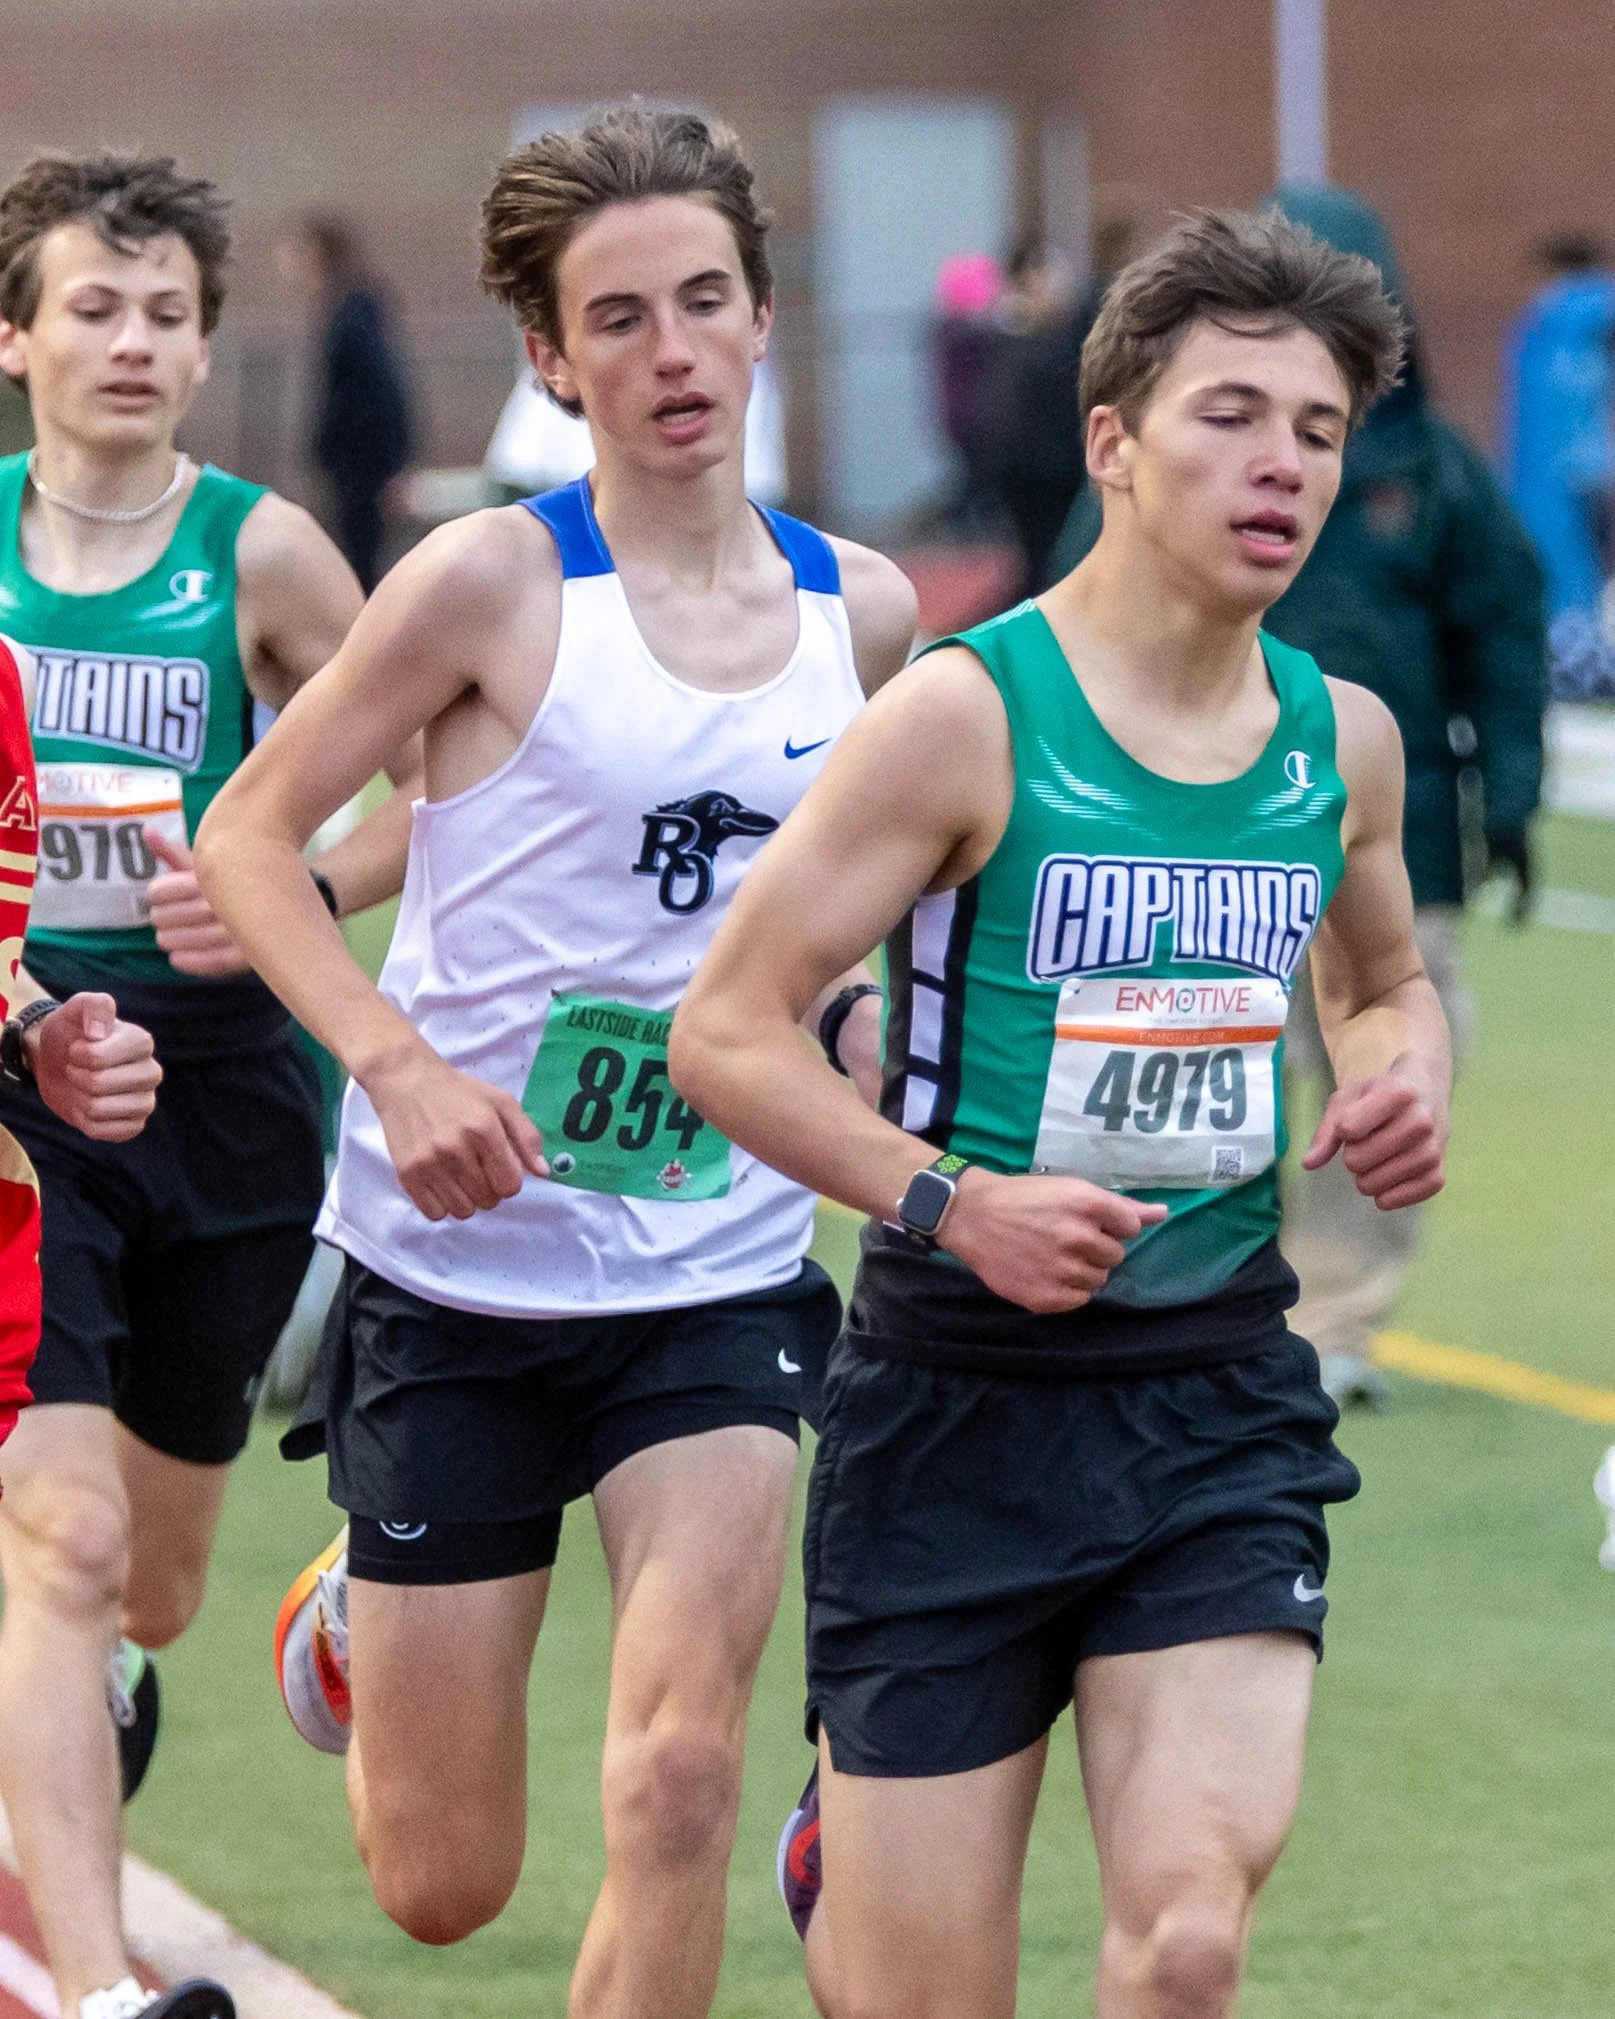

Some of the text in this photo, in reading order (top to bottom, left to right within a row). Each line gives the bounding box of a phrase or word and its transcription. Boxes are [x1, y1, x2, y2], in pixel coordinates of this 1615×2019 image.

[37, 822, 157, 882] 970
[1031, 856, 1319, 981] CAPTAINS
[566, 1005, 641, 1041] EASTSIDE
[562, 1046, 705, 1151] 854
[1083, 1048, 1247, 1134] 4979
